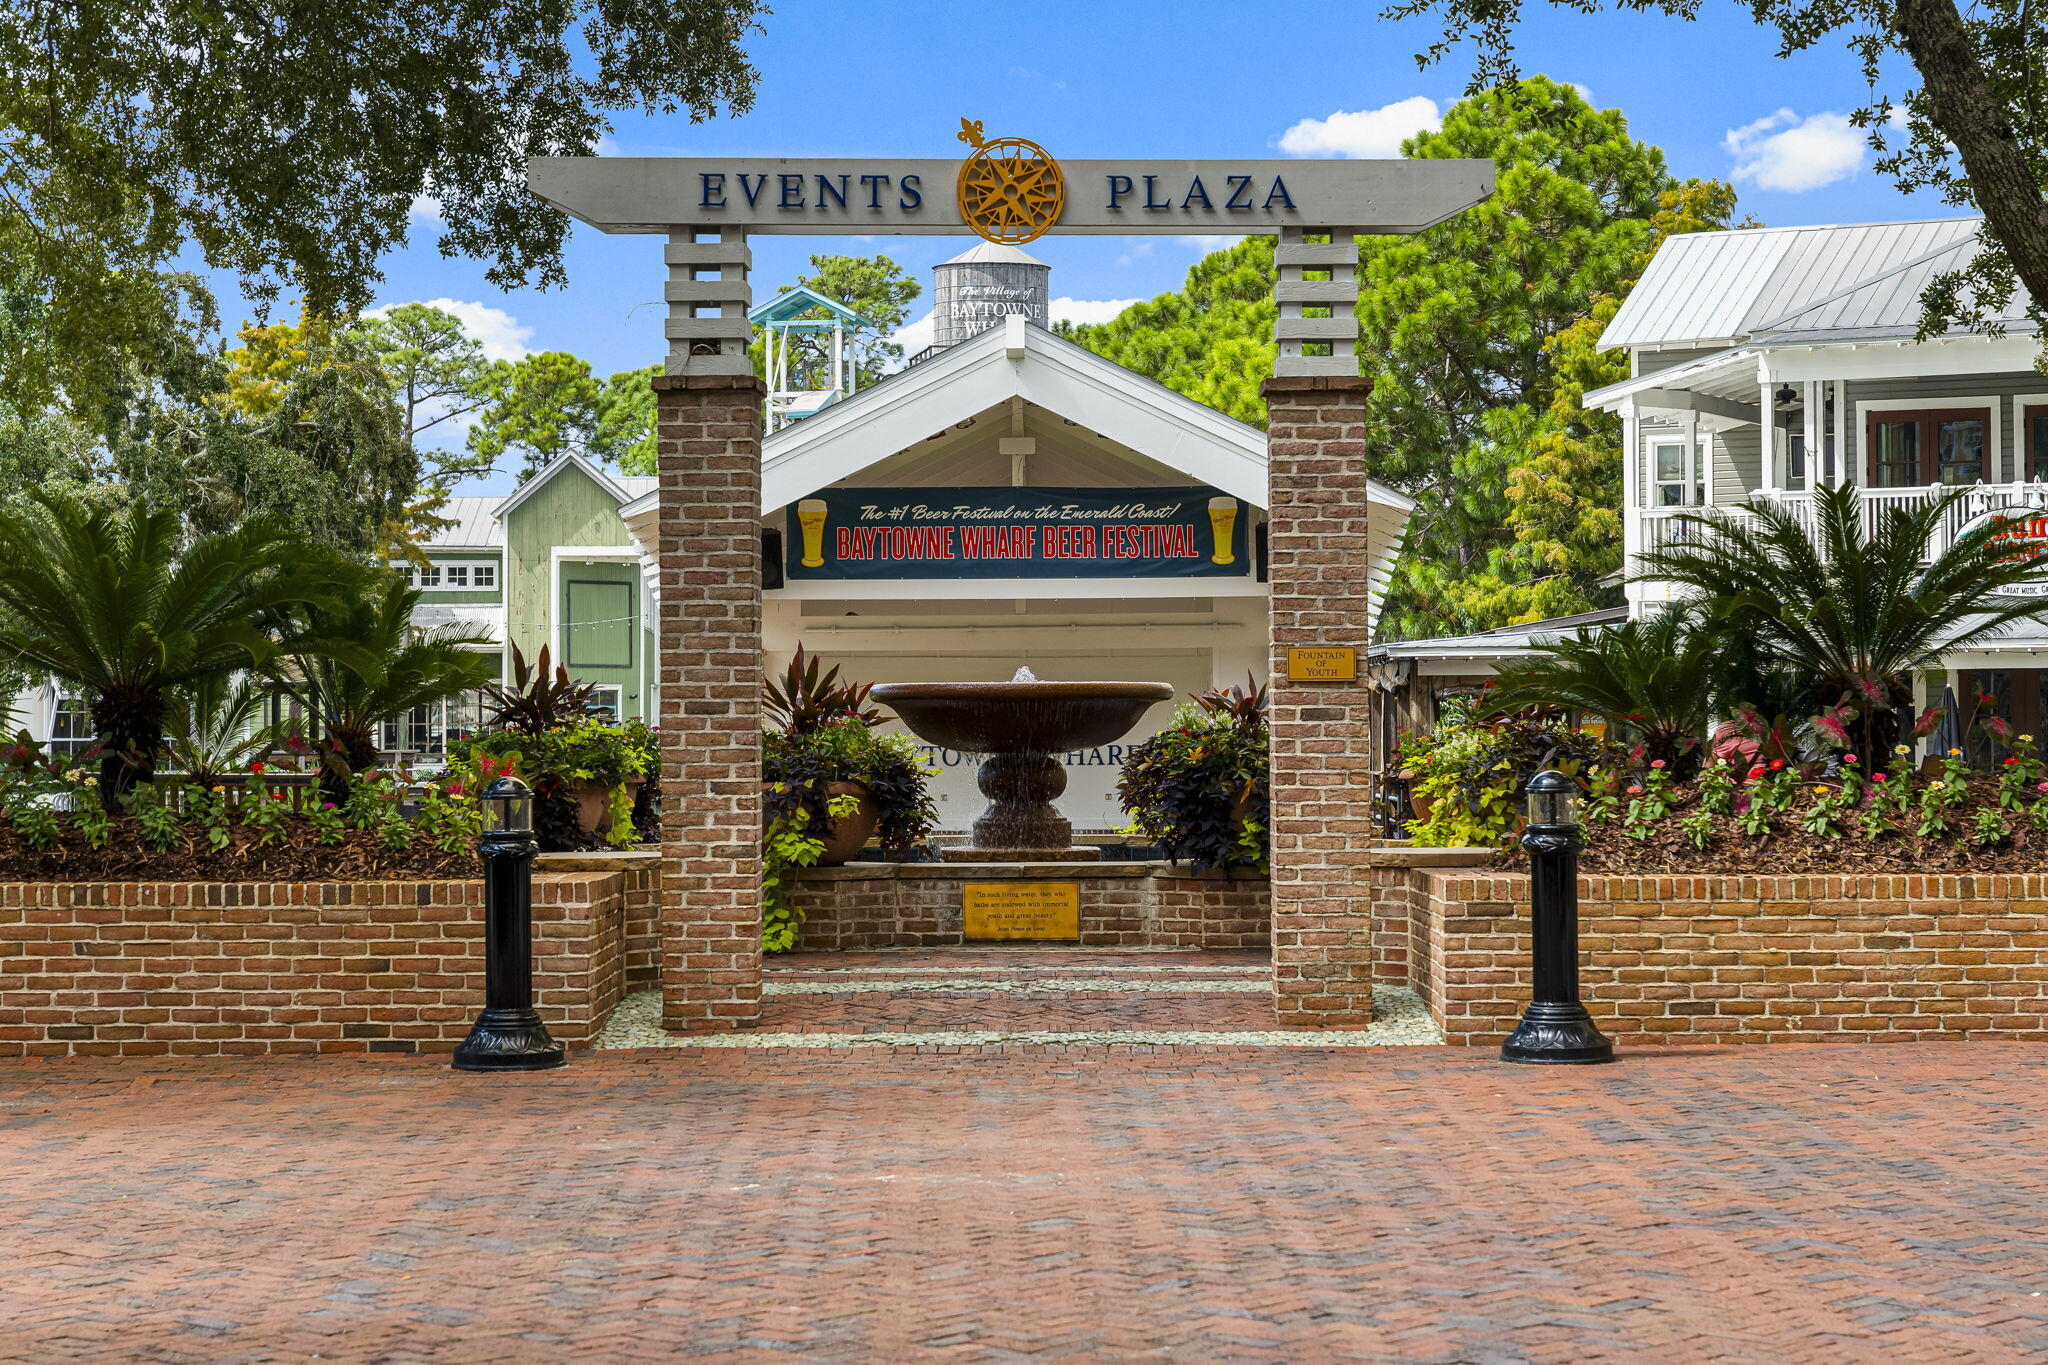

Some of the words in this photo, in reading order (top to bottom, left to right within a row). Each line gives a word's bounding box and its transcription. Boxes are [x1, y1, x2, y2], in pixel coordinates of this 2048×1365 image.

[698, 173, 922, 209] EVENTS
[1106, 175, 1297, 209] PLAZA
[959, 286, 979, 296] The
[983, 286, 1020, 299] Village
[1023, 287, 1034, 300] of
[950, 302, 1041, 319] BAYTOWNE
[860, 505, 886, 520] The
[887, 504, 910, 521] #1
[911, 504, 950, 520] Beer
[950, 504, 1013, 520] Festival
[1013, 509, 1034, 519] on
[1034, 504, 1060, 519] the
[1060, 503, 1127, 520] Emerald
[1127, 502, 1182, 520] Coast!
[837, 526, 955, 560] BAYTOWNE
[960, 525, 1037, 560] WHARF
[1042, 525, 1096, 560] BEER
[1102, 524, 1199, 559] FESTIVAL
[1002, 891, 1019, 899] living
